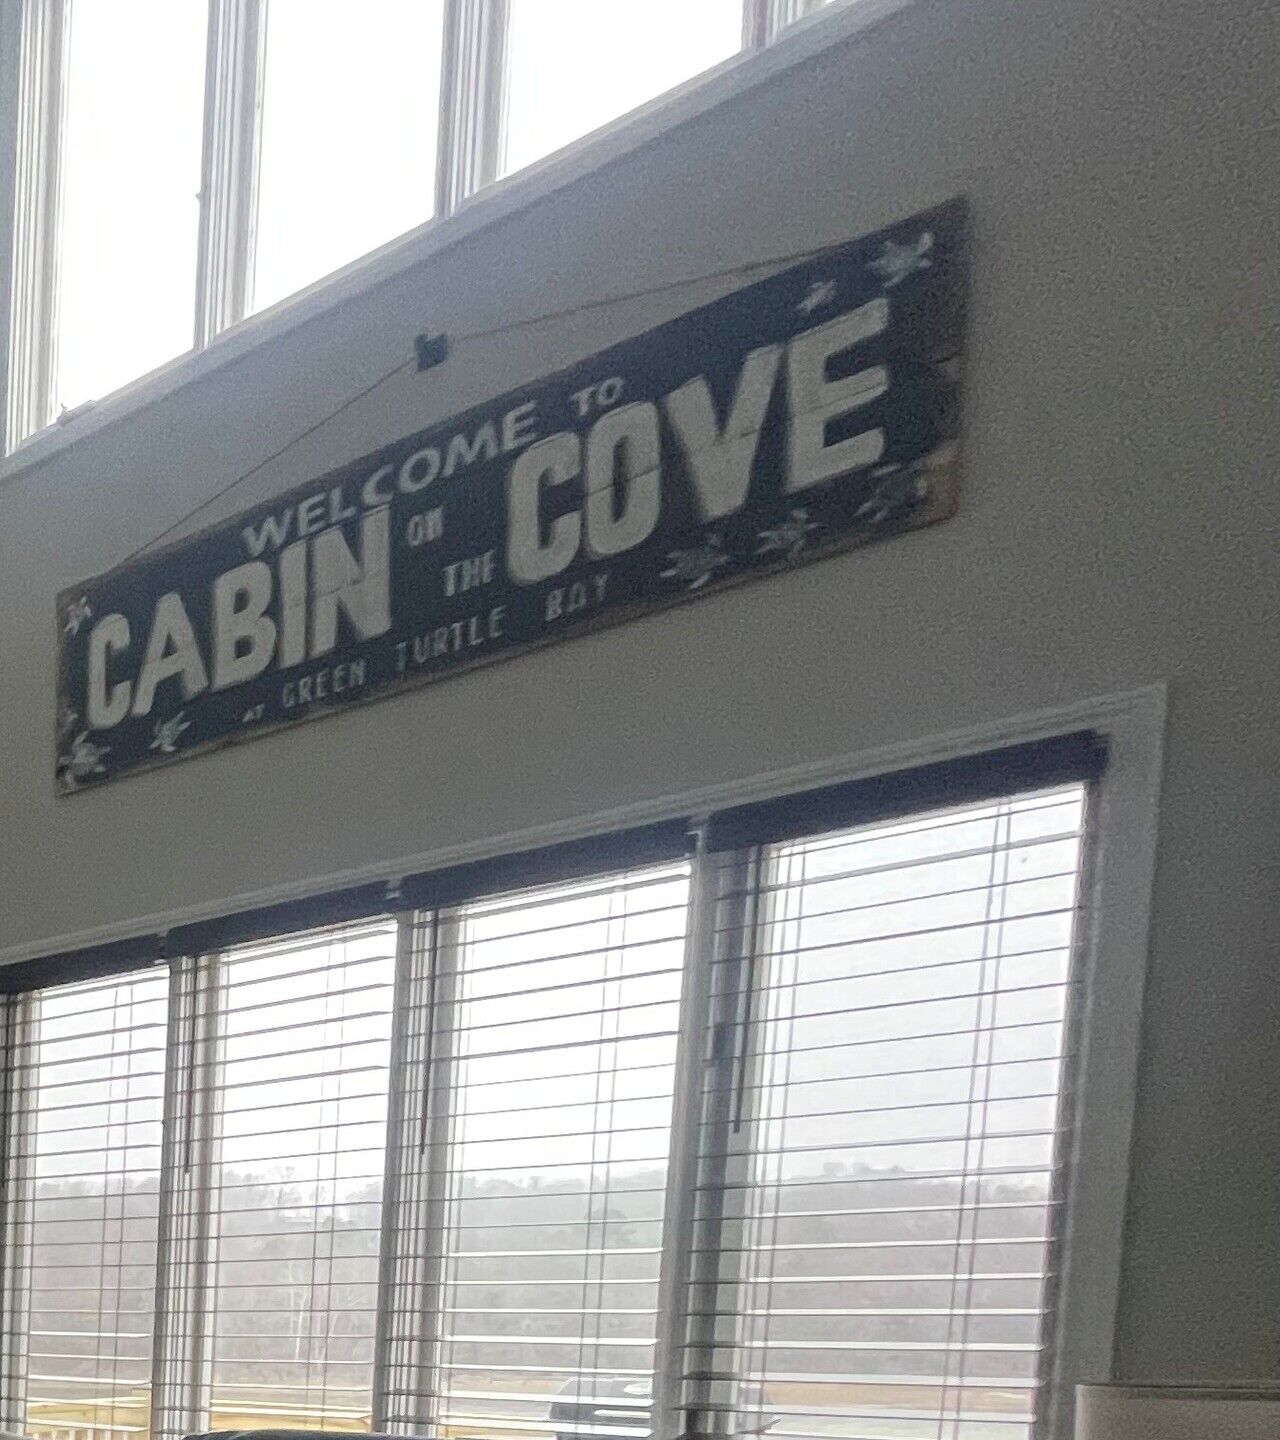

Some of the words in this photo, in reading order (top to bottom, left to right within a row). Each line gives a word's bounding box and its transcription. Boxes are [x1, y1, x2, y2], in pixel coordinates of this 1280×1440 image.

[86, 503, 391, 730] CABIN
[406, 505, 444, 547] ON
[443, 552, 496, 598] THE
[507, 297, 889, 585] COVE
[241, 401, 537, 557] WELCOME
[570, 376, 624, 417] TO
[242, 705, 265, 723] AT
[282, 659, 366, 709] GREEN
[394, 605, 507, 672] TURTLE
[546, 574, 609, 622] BAY
